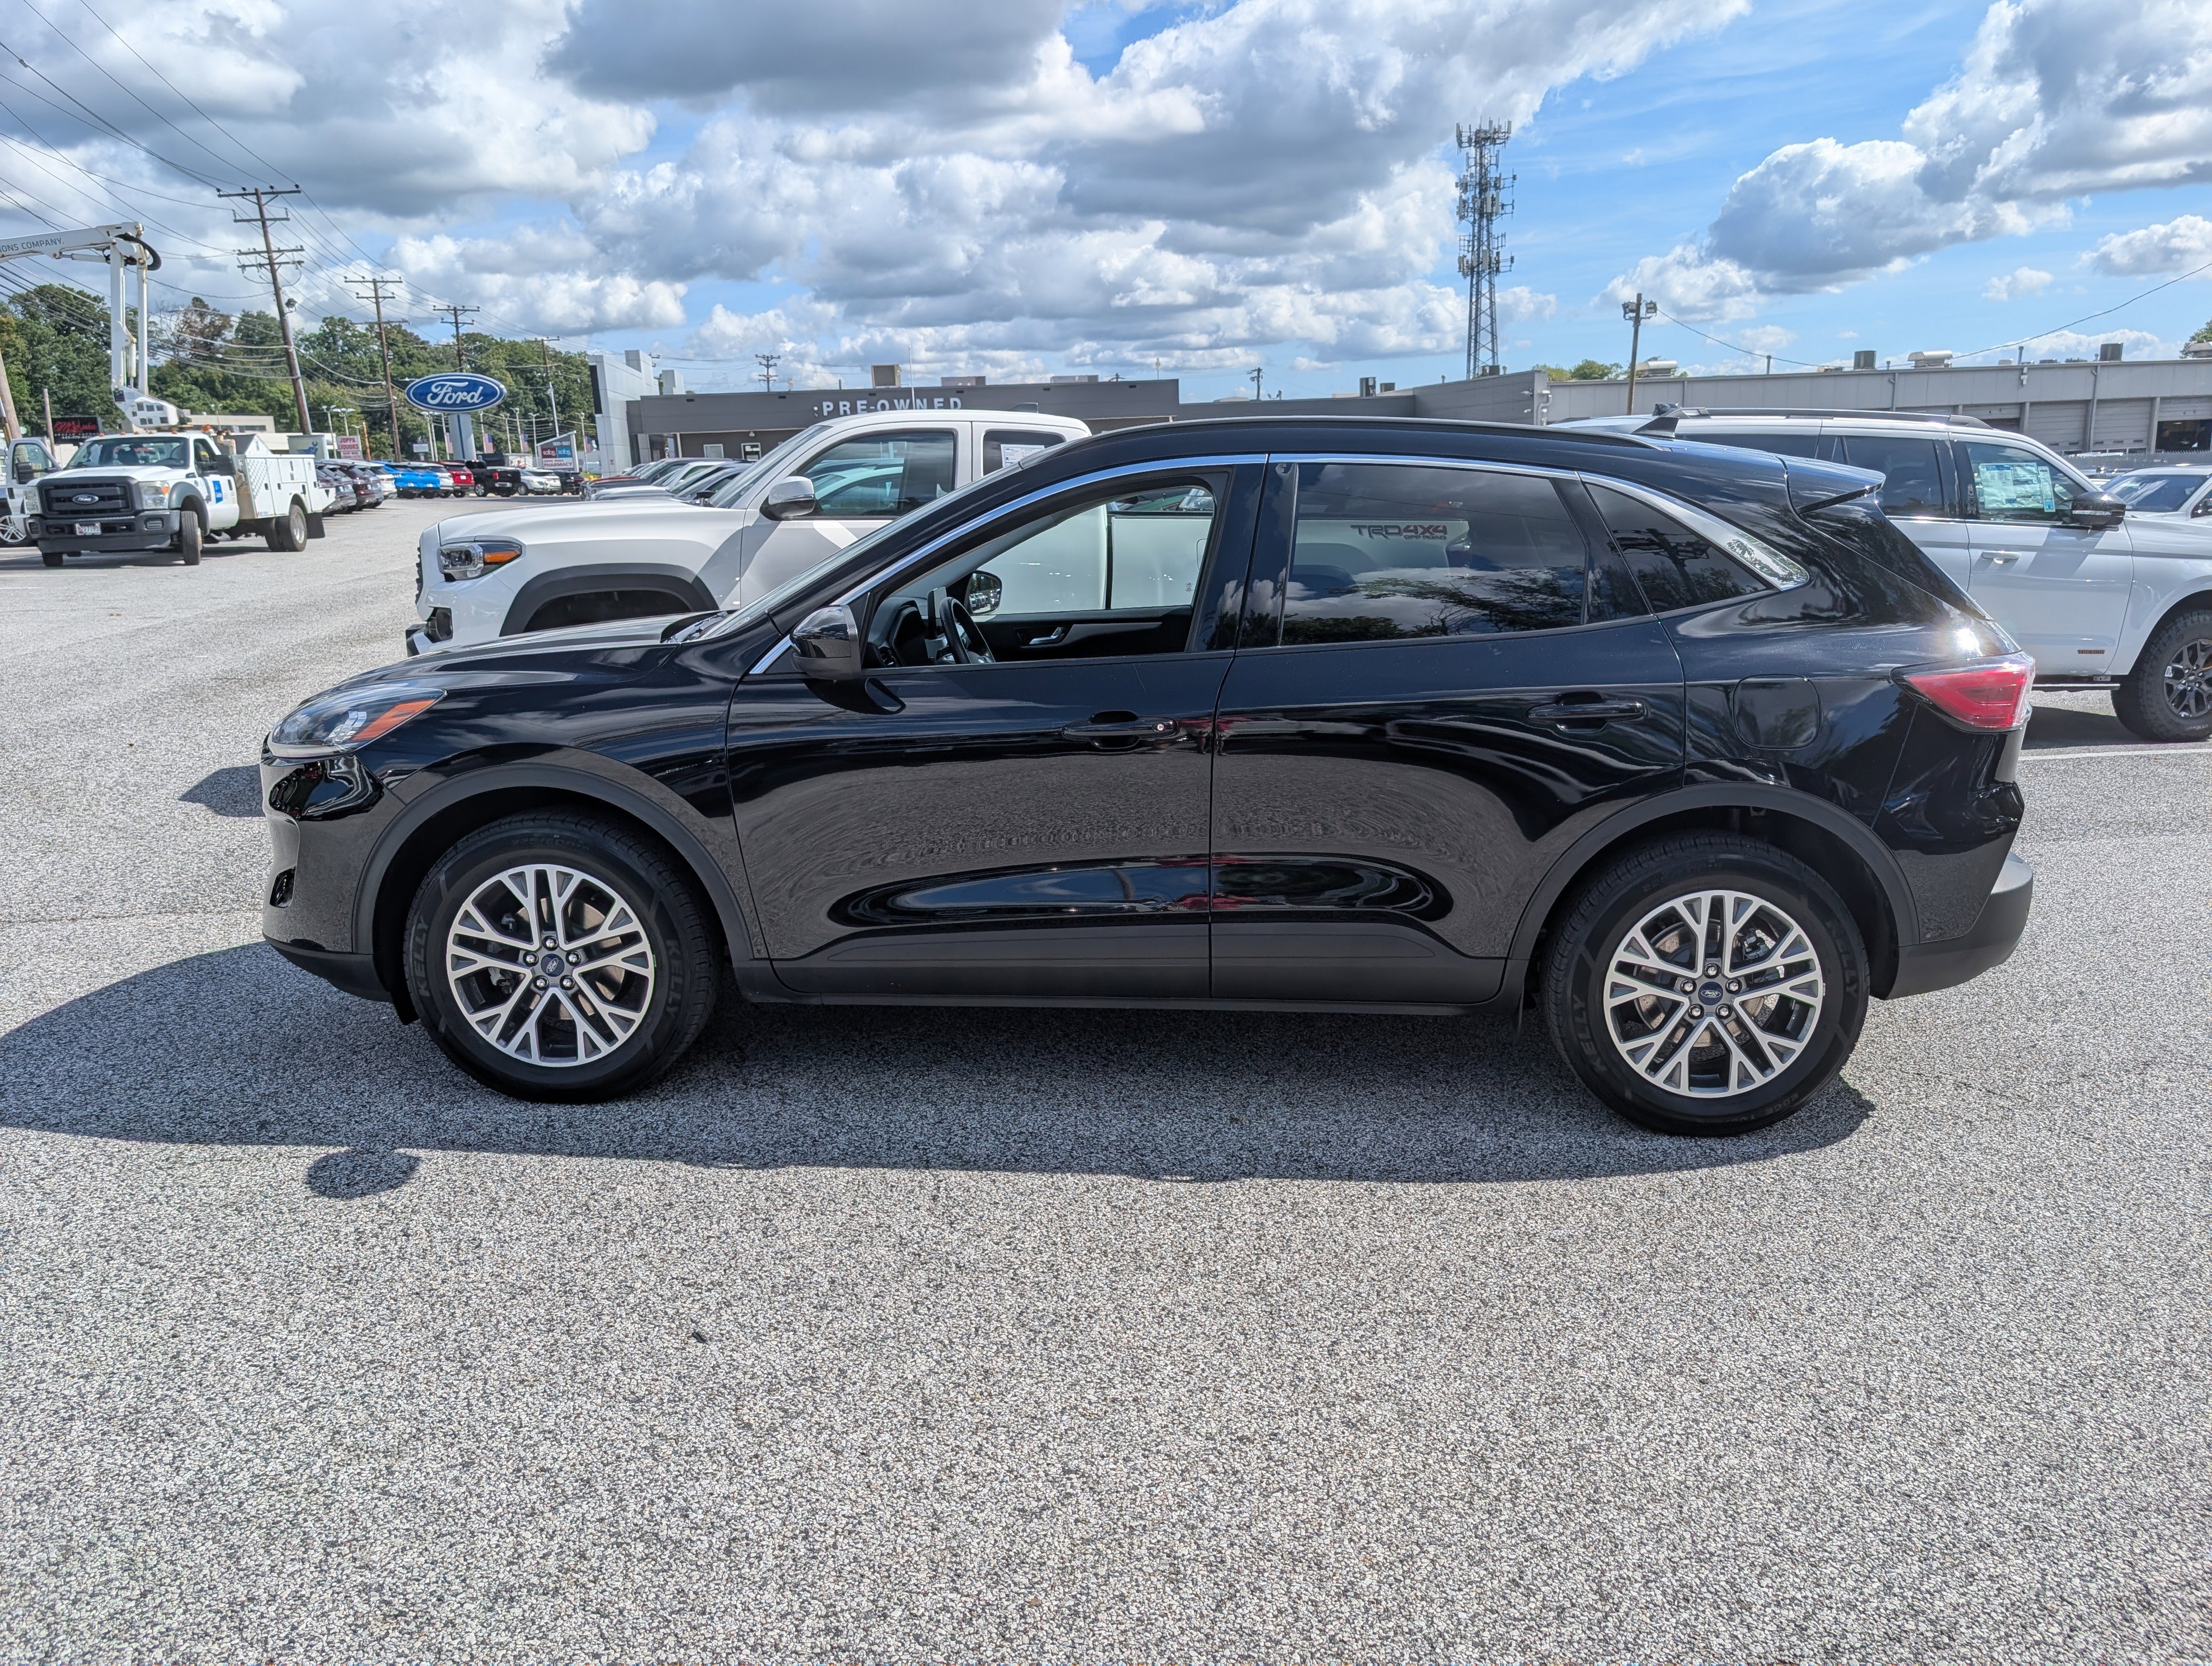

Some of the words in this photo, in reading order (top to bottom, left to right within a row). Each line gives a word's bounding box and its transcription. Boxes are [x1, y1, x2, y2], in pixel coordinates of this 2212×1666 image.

[0, 244, 19, 253] ONS
[22, 238, 65, 249] COMPANY.
[427, 381, 484, 405] Ford
[822, 397, 962, 416] PRE-OWNED
[1350, 524, 1403, 540] TRD
[1402, 524, 1448, 535] 4X4
[414, 915, 430, 997] KELLY
[665, 939, 683, 1018] KELLY
[1572, 994, 1607, 1072] KELLY
